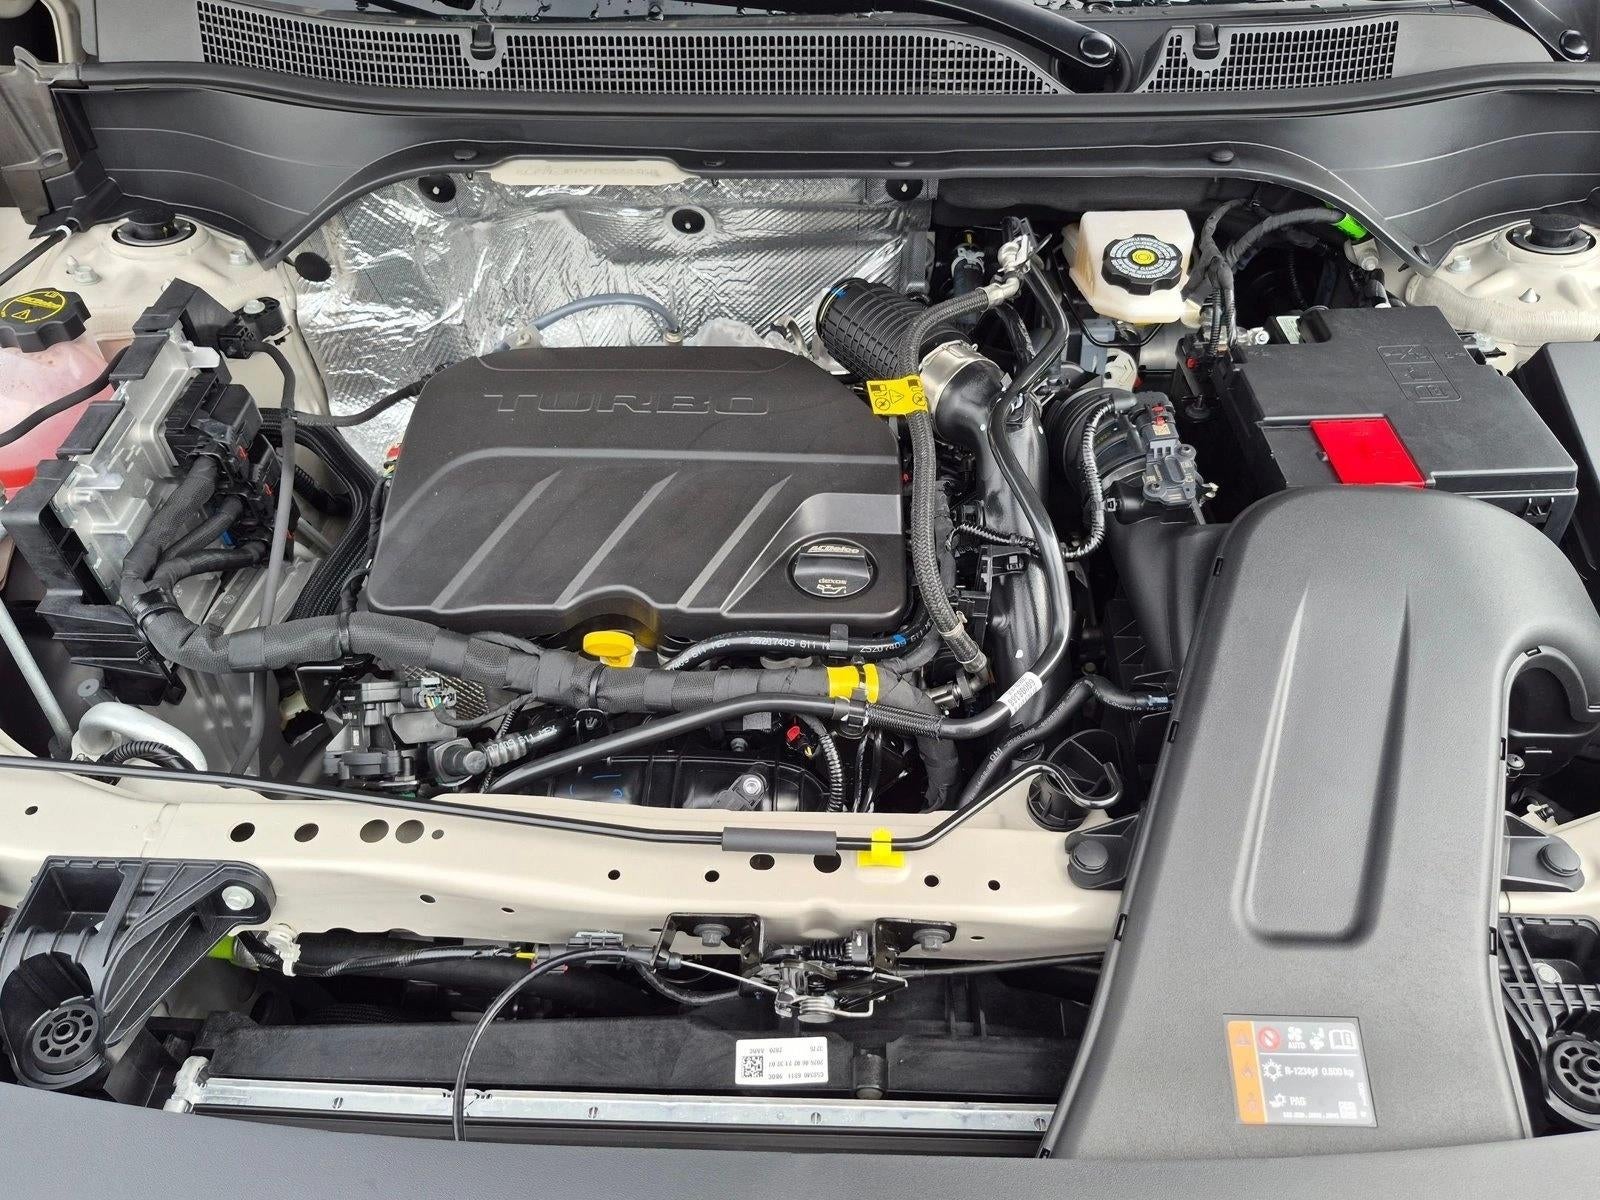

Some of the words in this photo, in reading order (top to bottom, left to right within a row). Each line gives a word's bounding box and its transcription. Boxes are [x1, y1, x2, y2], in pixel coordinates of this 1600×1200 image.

[484, 394, 768, 414] TURBO
[807, 545, 860, 554] ACDelco
[818, 577, 848, 585] dexos
